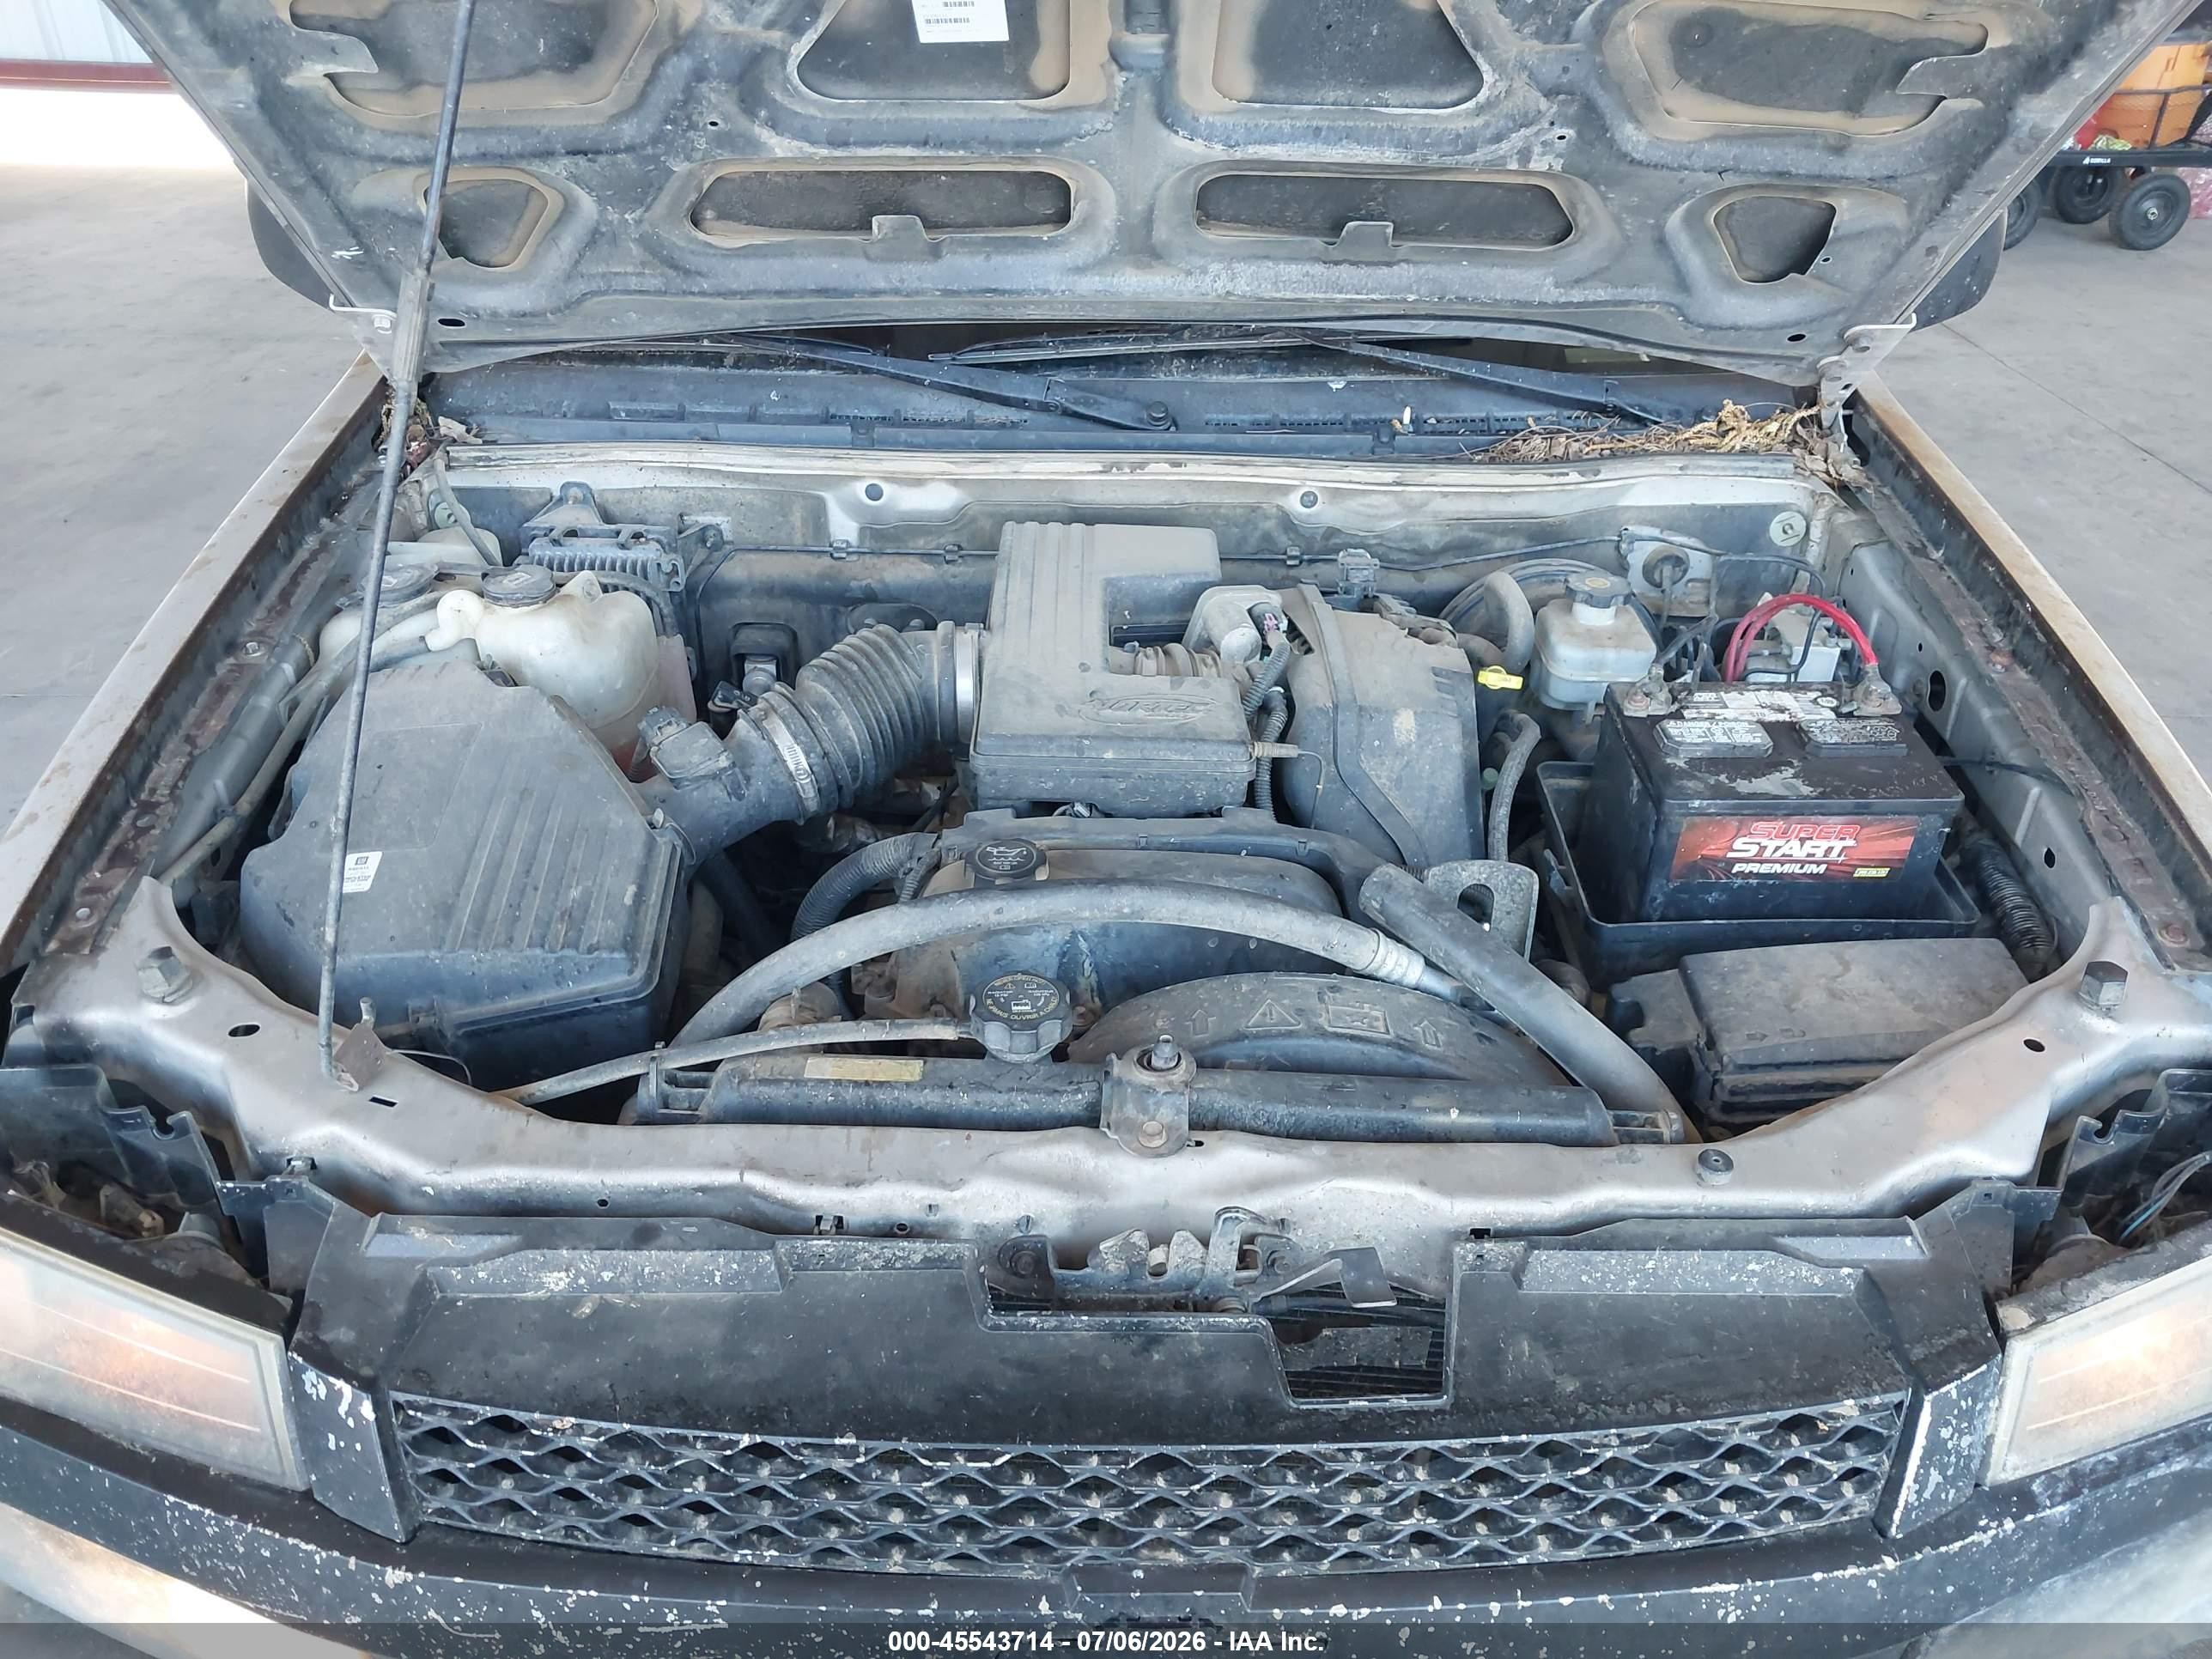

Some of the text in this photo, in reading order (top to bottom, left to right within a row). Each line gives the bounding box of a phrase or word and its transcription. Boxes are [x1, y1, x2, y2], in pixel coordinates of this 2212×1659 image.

[1747, 822, 1861, 841] SUPER
[1726, 836, 1856, 861] START
[1731, 863, 1827, 874] PREMIUM
